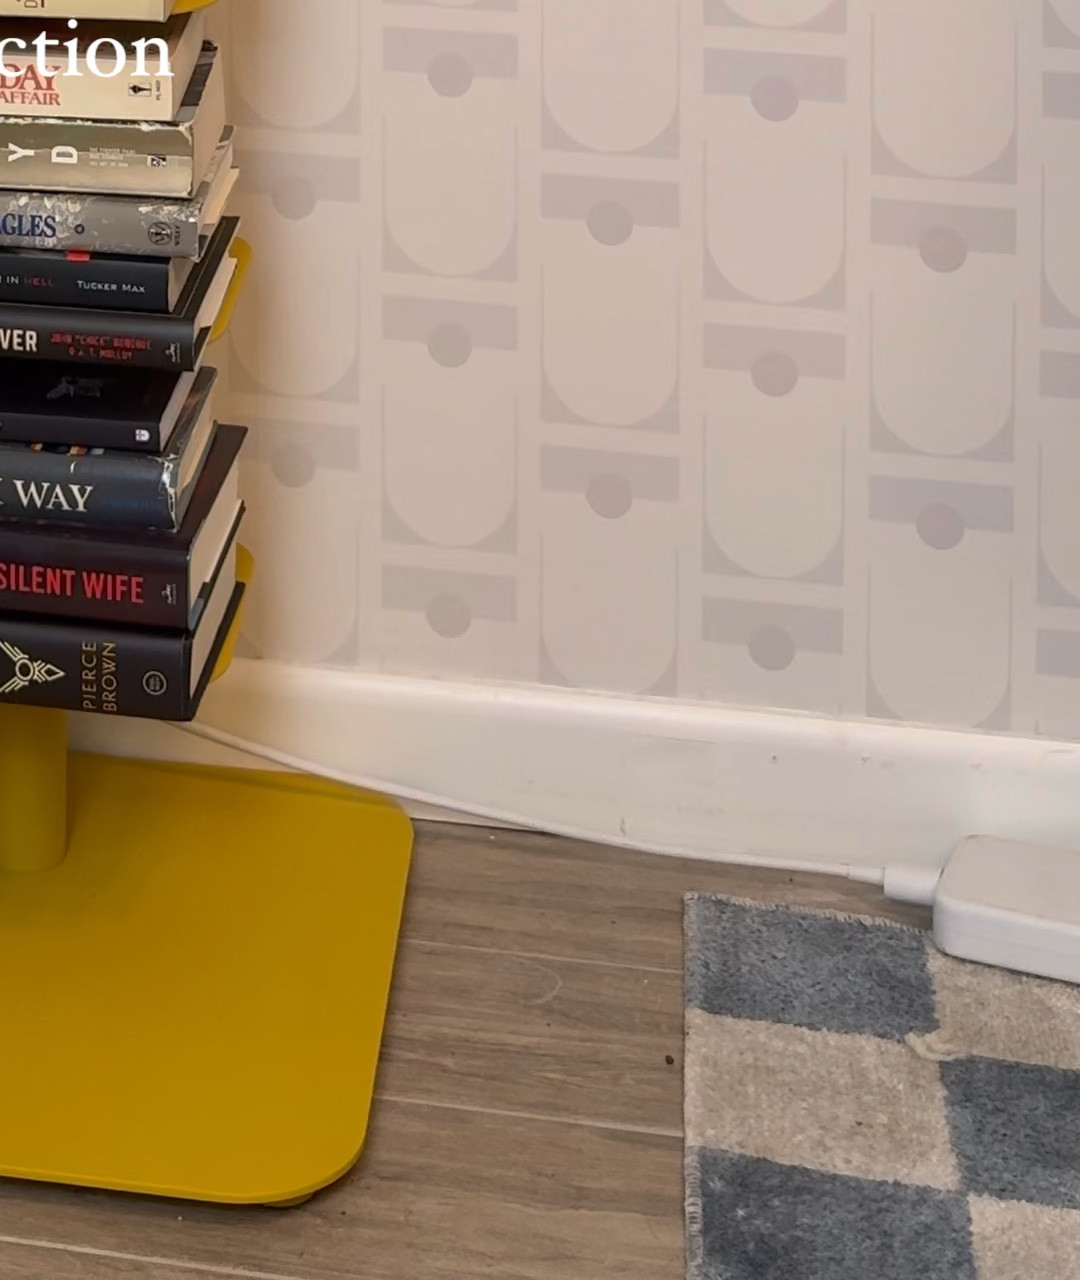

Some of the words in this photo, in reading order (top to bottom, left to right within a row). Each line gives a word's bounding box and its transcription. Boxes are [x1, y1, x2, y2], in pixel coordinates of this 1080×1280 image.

[13, 479, 94, 512] WAY
[81, 571, 144, 603] WIFE
[82, 641, 97, 710] PIERCE
[102, 642, 117, 712] BROWN
